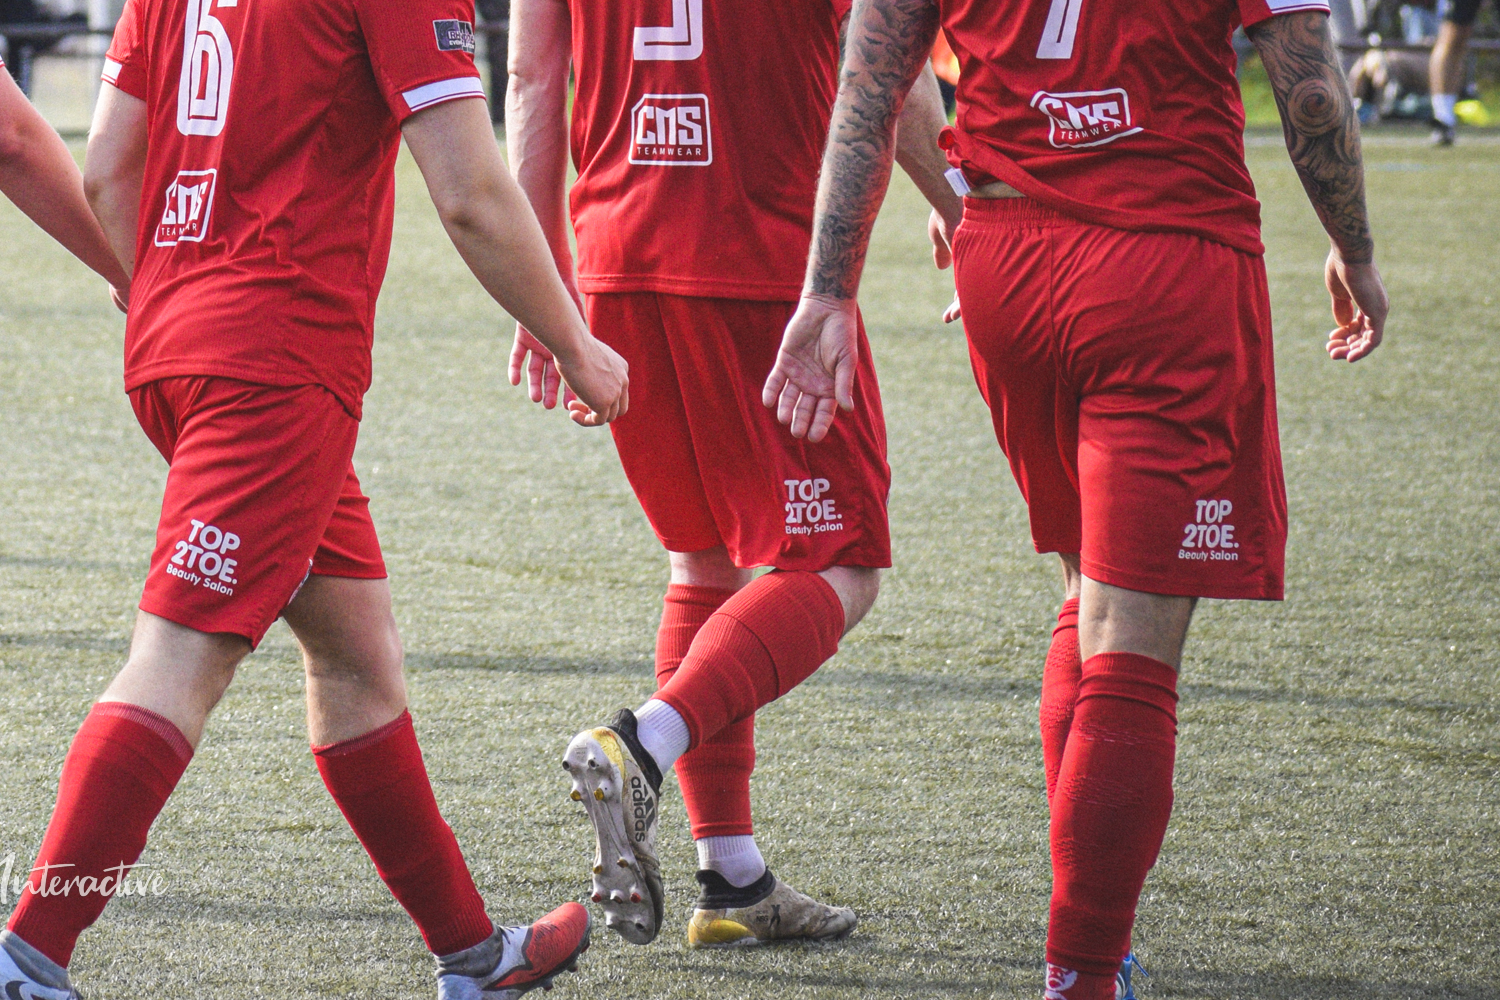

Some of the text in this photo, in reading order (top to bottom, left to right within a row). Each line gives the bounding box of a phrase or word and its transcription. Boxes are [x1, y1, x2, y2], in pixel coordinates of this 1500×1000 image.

[636, 105, 703, 145] CMS
[1061, 121, 1122, 140] TEAMWEA
[637, 147, 701, 156] TEAMWEAR
[784, 478, 830, 501] TOP
[1196, 500, 1233, 523] TOP
[188, 519, 240, 554] TOP
[814, 522, 843, 533] Salon
[1178, 549, 1238, 562] Beauty Salon
[166, 563, 233, 596] Beauty Salon
[631, 776, 646, 842] adidas
